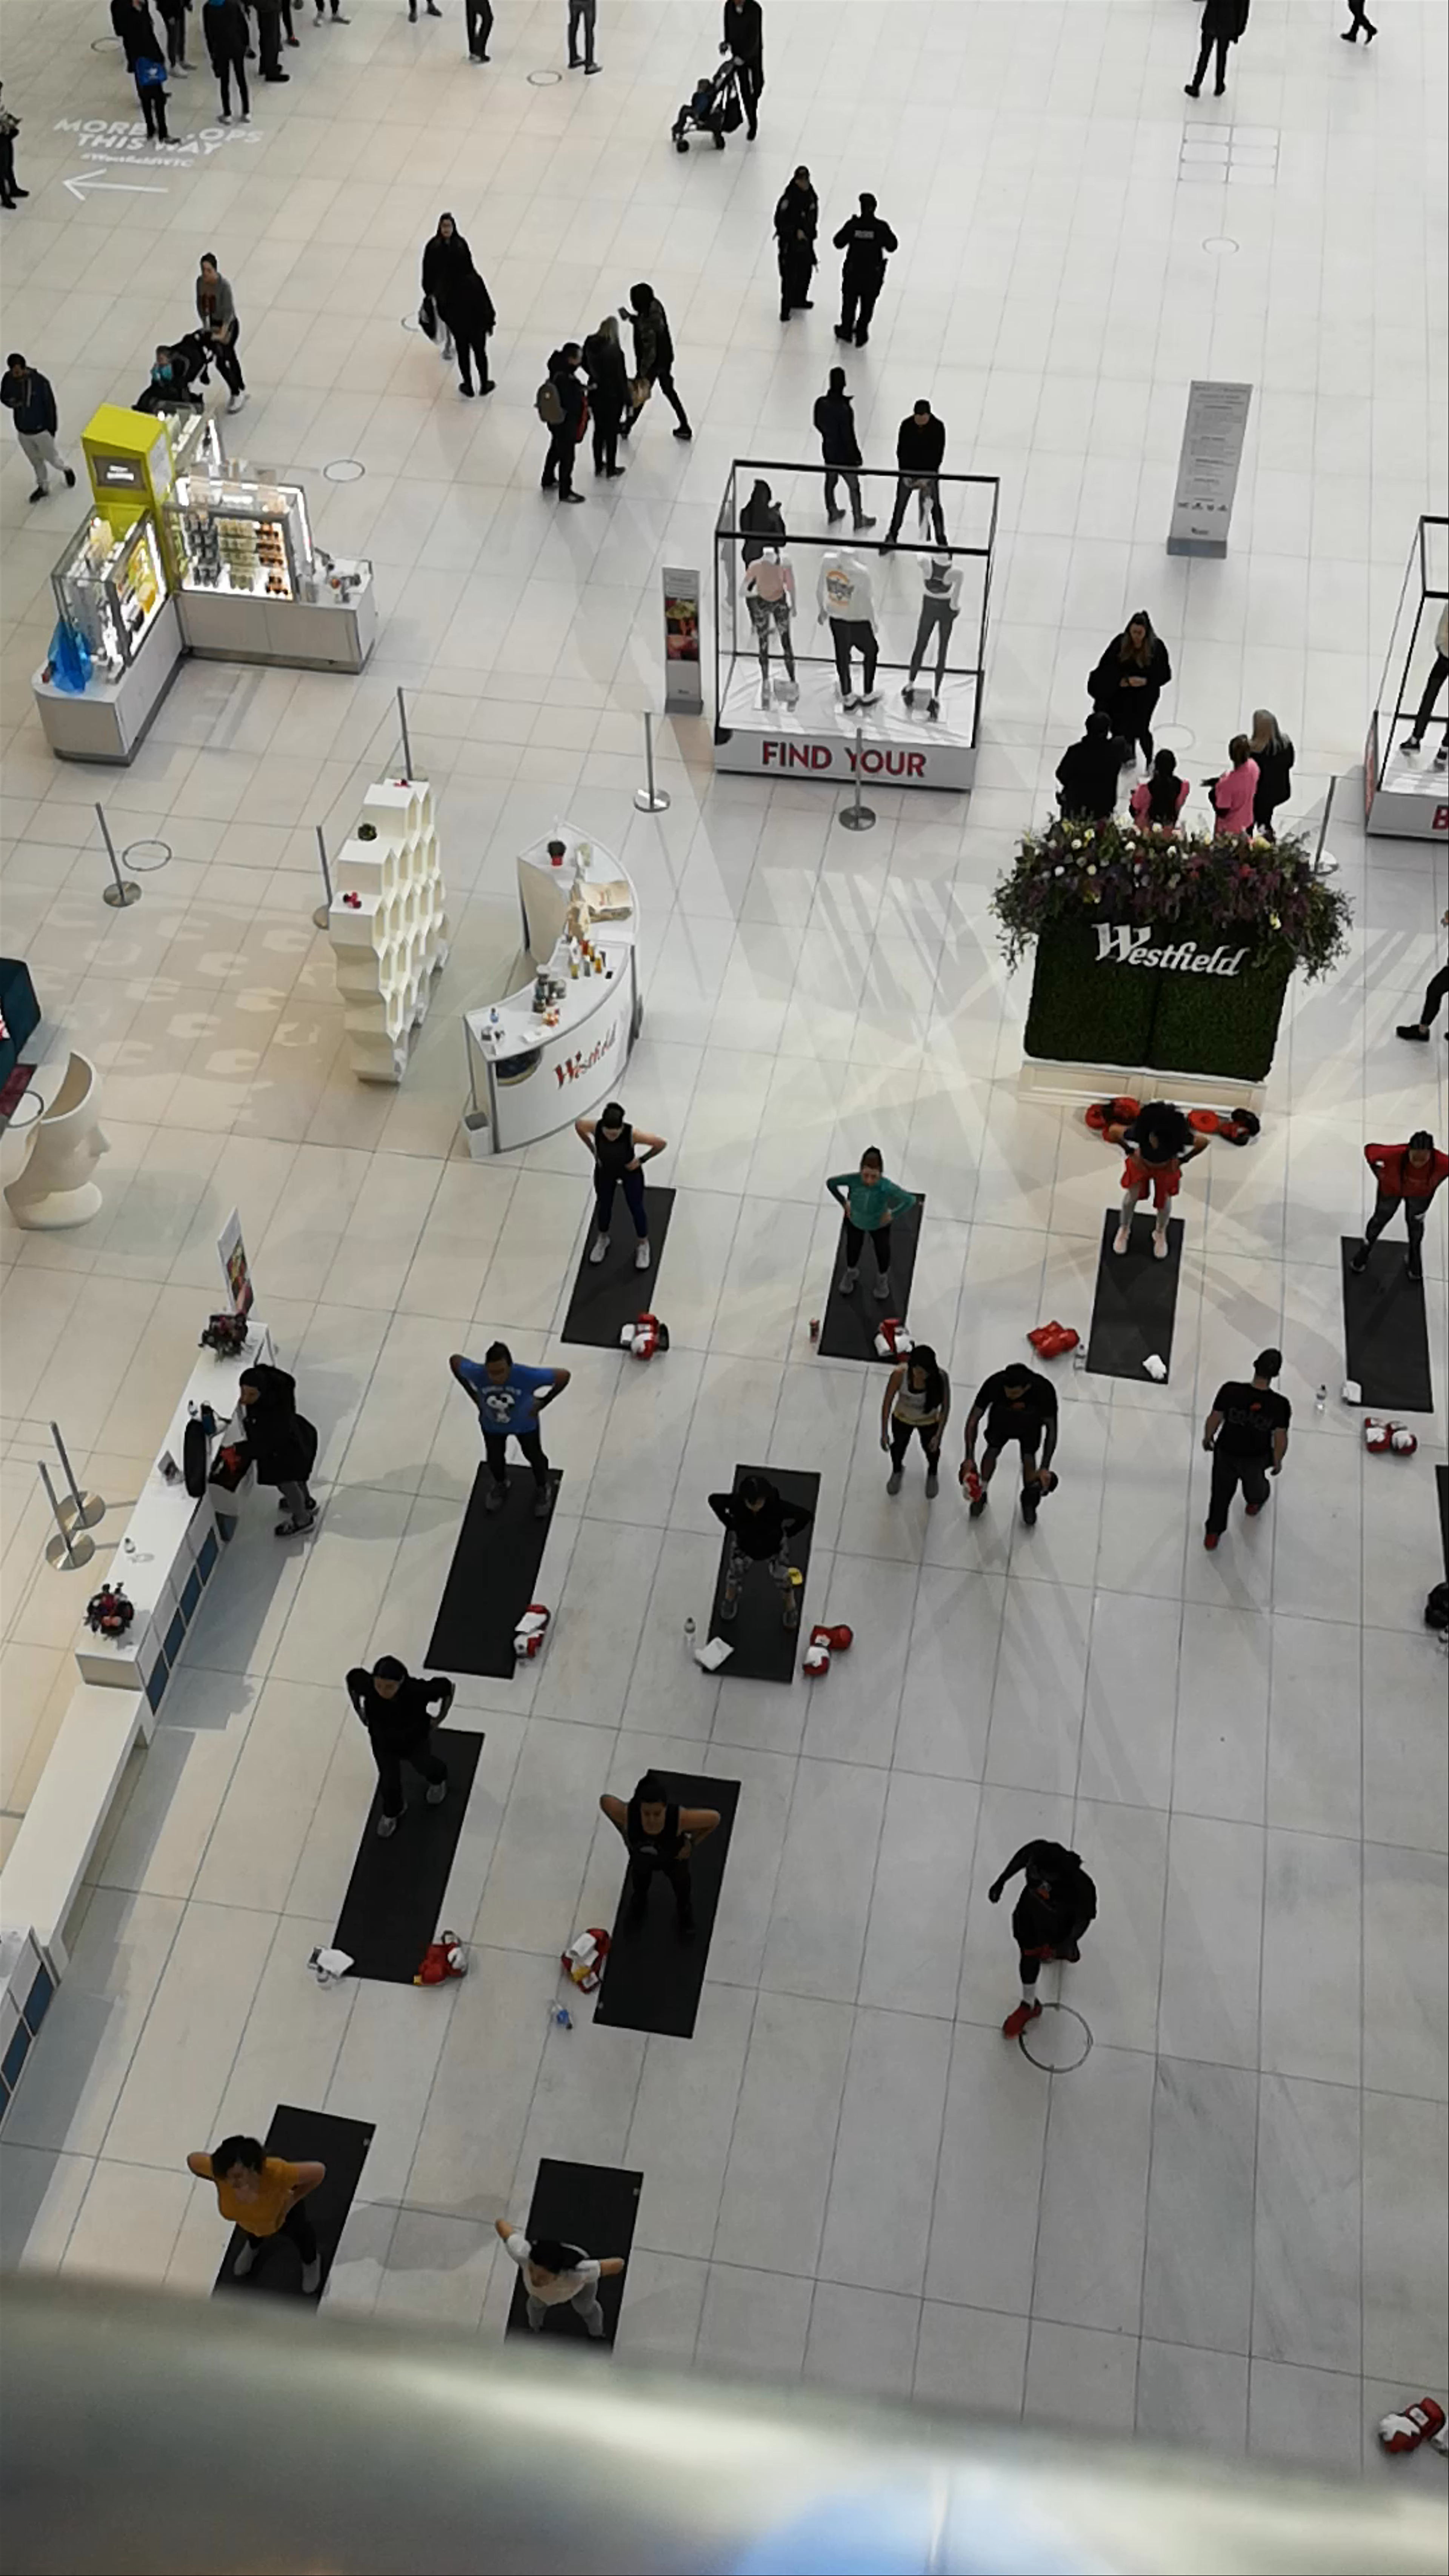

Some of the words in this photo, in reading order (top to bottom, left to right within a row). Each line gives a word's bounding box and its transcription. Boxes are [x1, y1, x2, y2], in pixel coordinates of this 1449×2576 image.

[54, 118, 148, 136] MORE
[78, 133, 147, 151] THIS
[762, 741, 832, 770] FIND
[844, 747, 927, 777] YOUR
[1091, 922, 1250, 977] Westfield
